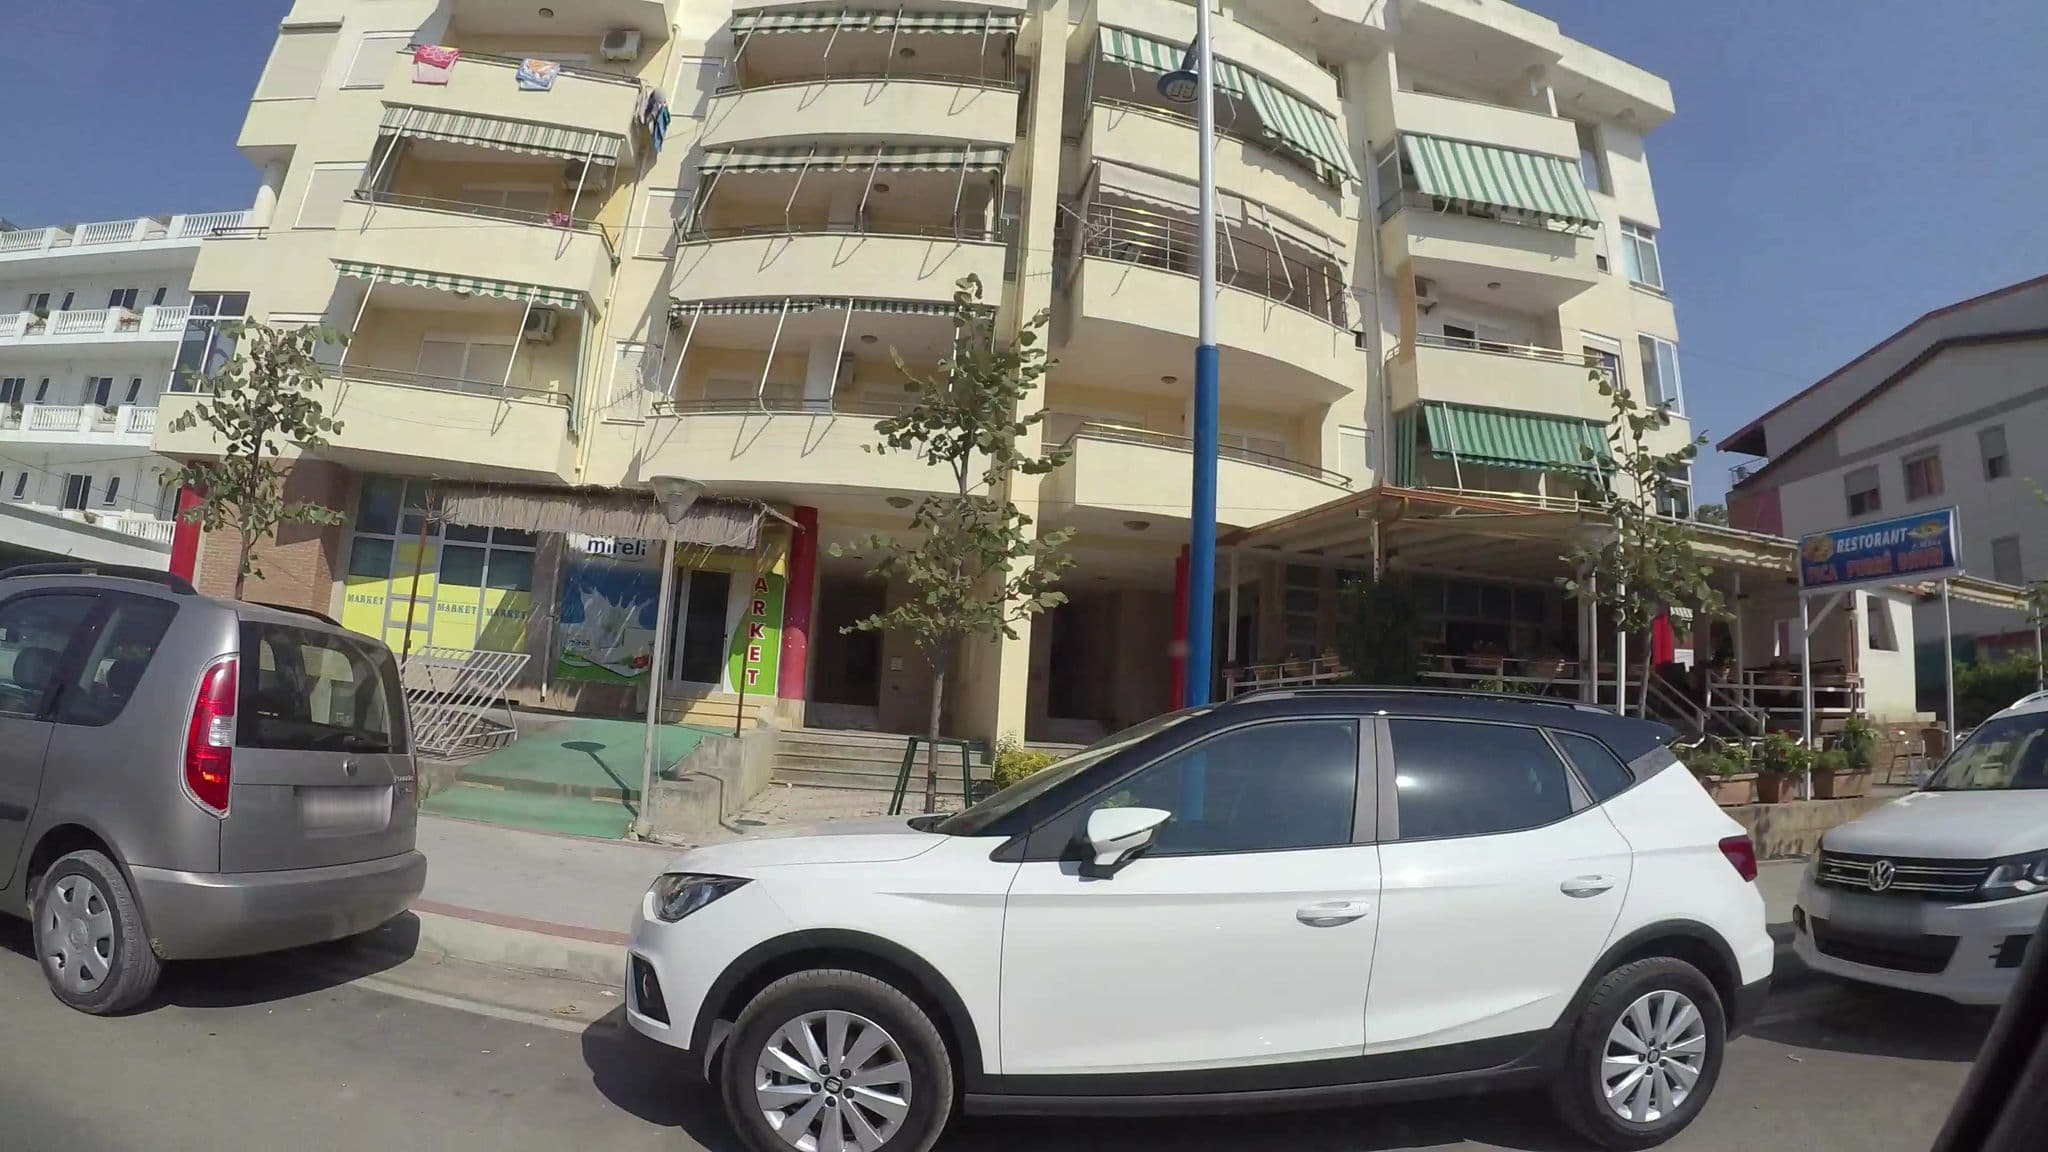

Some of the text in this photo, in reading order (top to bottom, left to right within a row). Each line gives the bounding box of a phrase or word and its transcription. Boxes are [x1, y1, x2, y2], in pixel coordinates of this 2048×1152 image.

[588, 539, 646, 555] mireli
[1837, 529, 1907, 552] RESTORANT
[347, 593, 385, 605] MARKET
[437, 603, 478, 615] MARKET
[485, 607, 528, 620] MARKET
